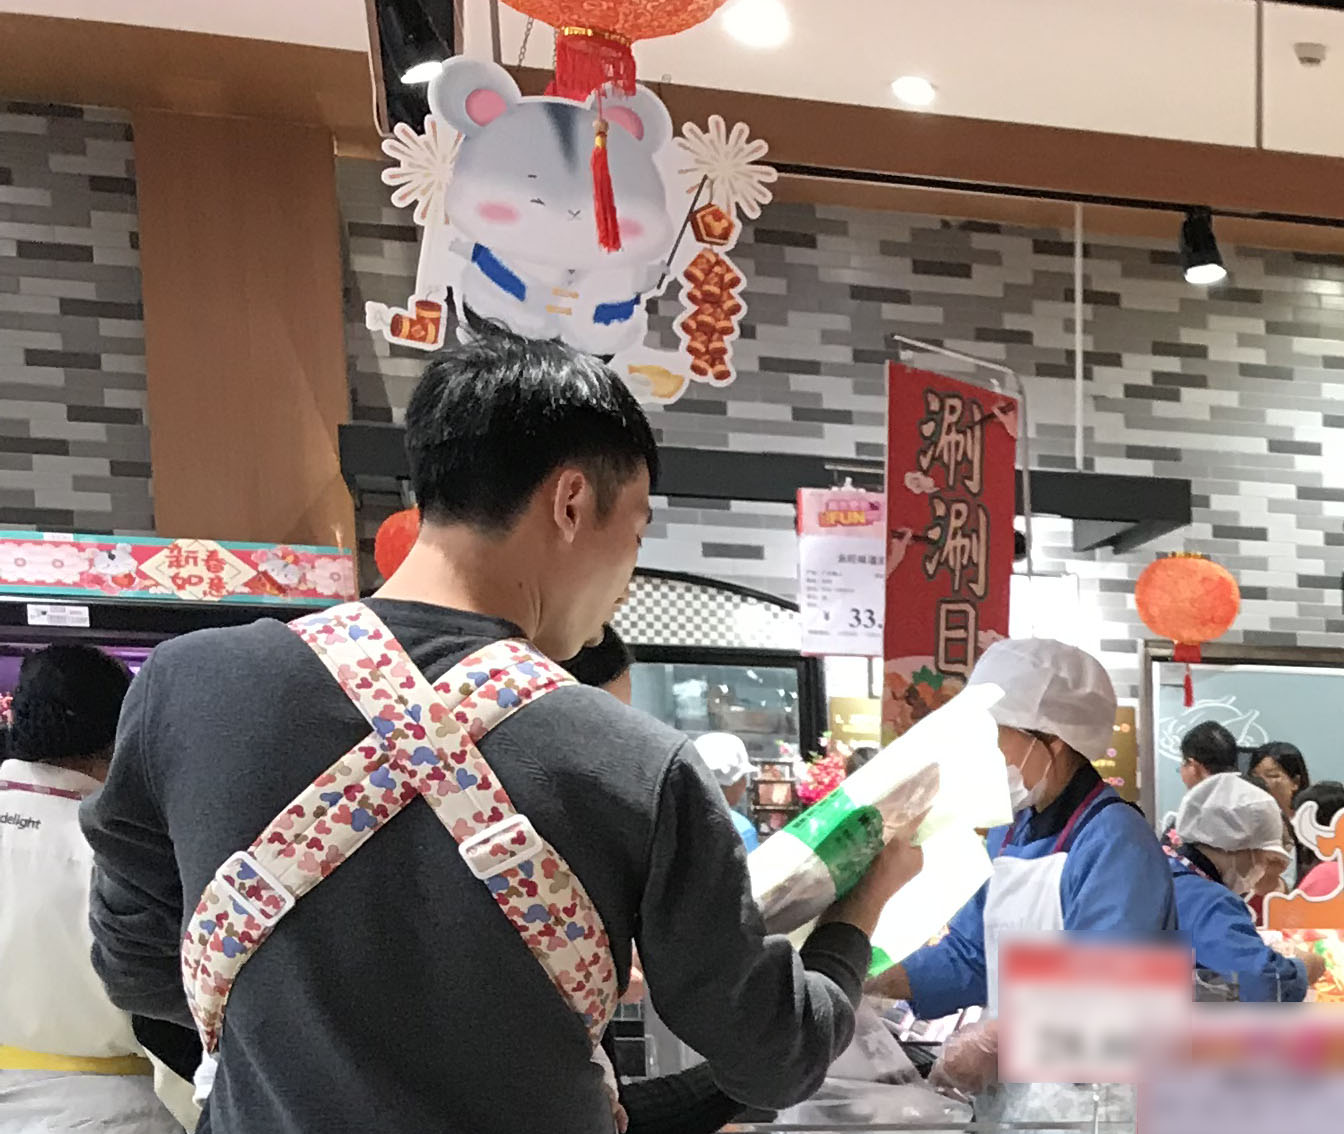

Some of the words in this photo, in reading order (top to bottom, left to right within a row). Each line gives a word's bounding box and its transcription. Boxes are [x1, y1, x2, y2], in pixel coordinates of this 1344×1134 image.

[165, 549, 226, 574] 新春
[917, 388, 989, 679] 涮涮日
